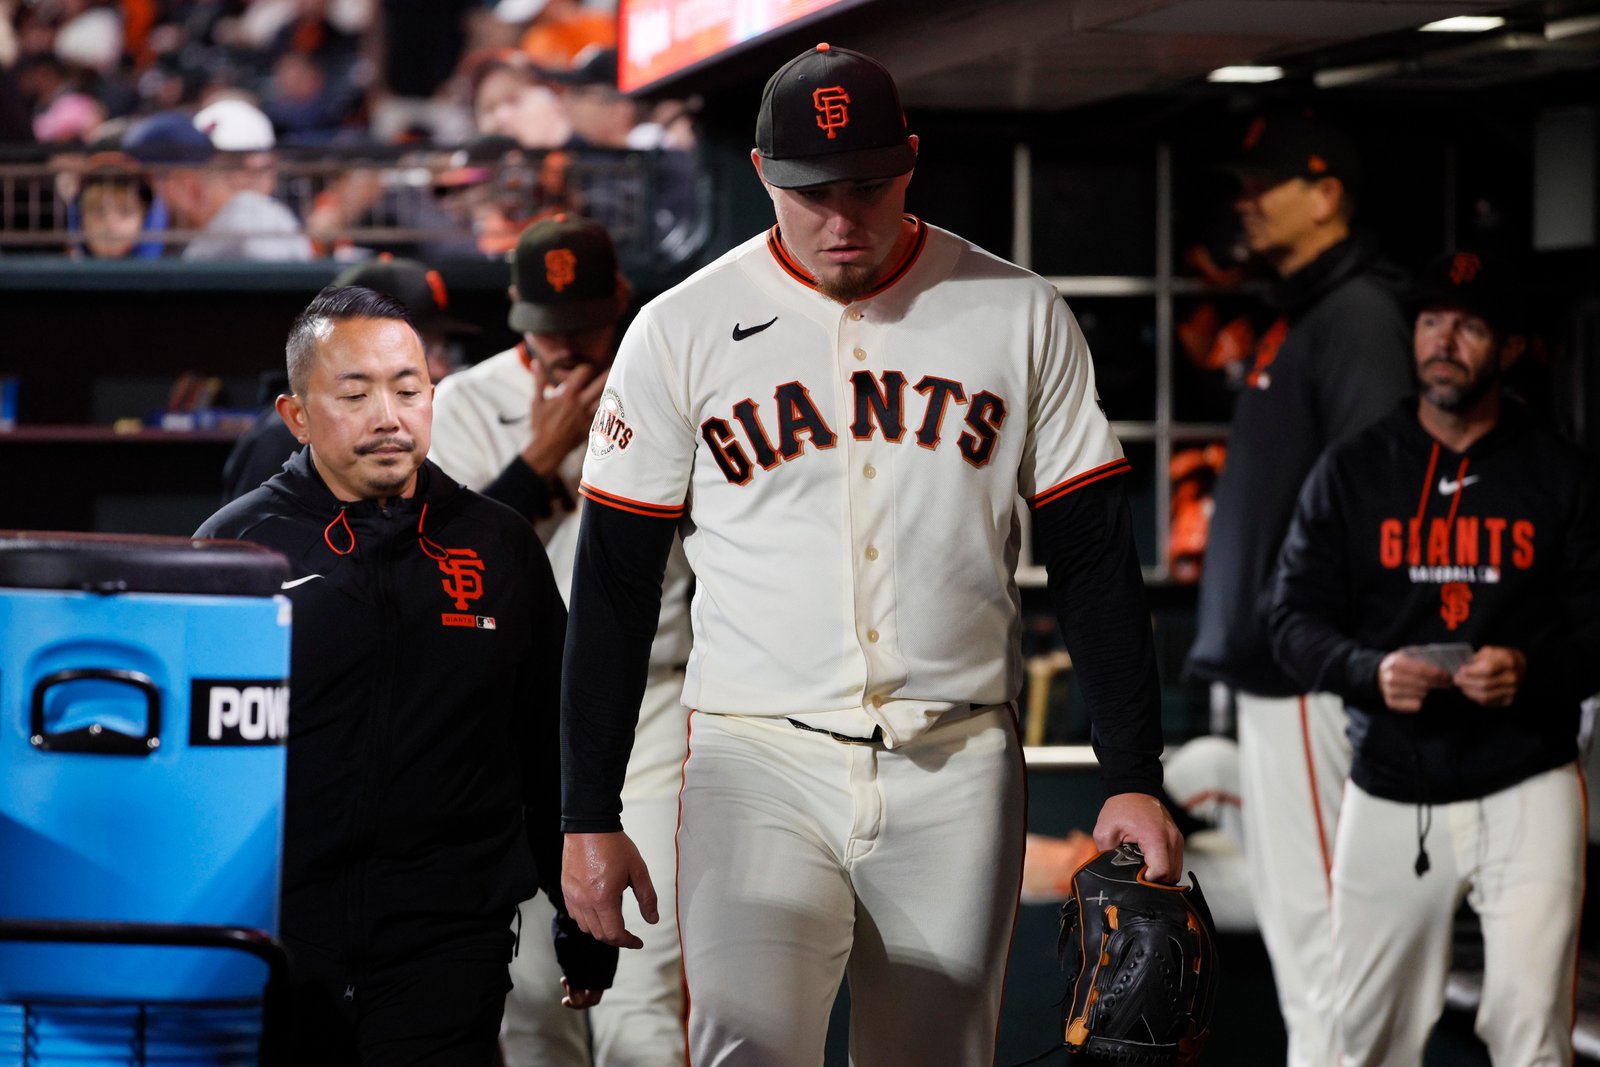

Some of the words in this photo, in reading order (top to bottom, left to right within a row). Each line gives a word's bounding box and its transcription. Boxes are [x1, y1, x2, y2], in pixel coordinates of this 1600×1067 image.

[812, 85, 851, 140] SF
[700, 369, 1008, 487] GIANTS
[1380, 516, 1535, 569] GIANTS
[438, 547, 486, 611] SF
[445, 616, 473, 625] GIANTS
